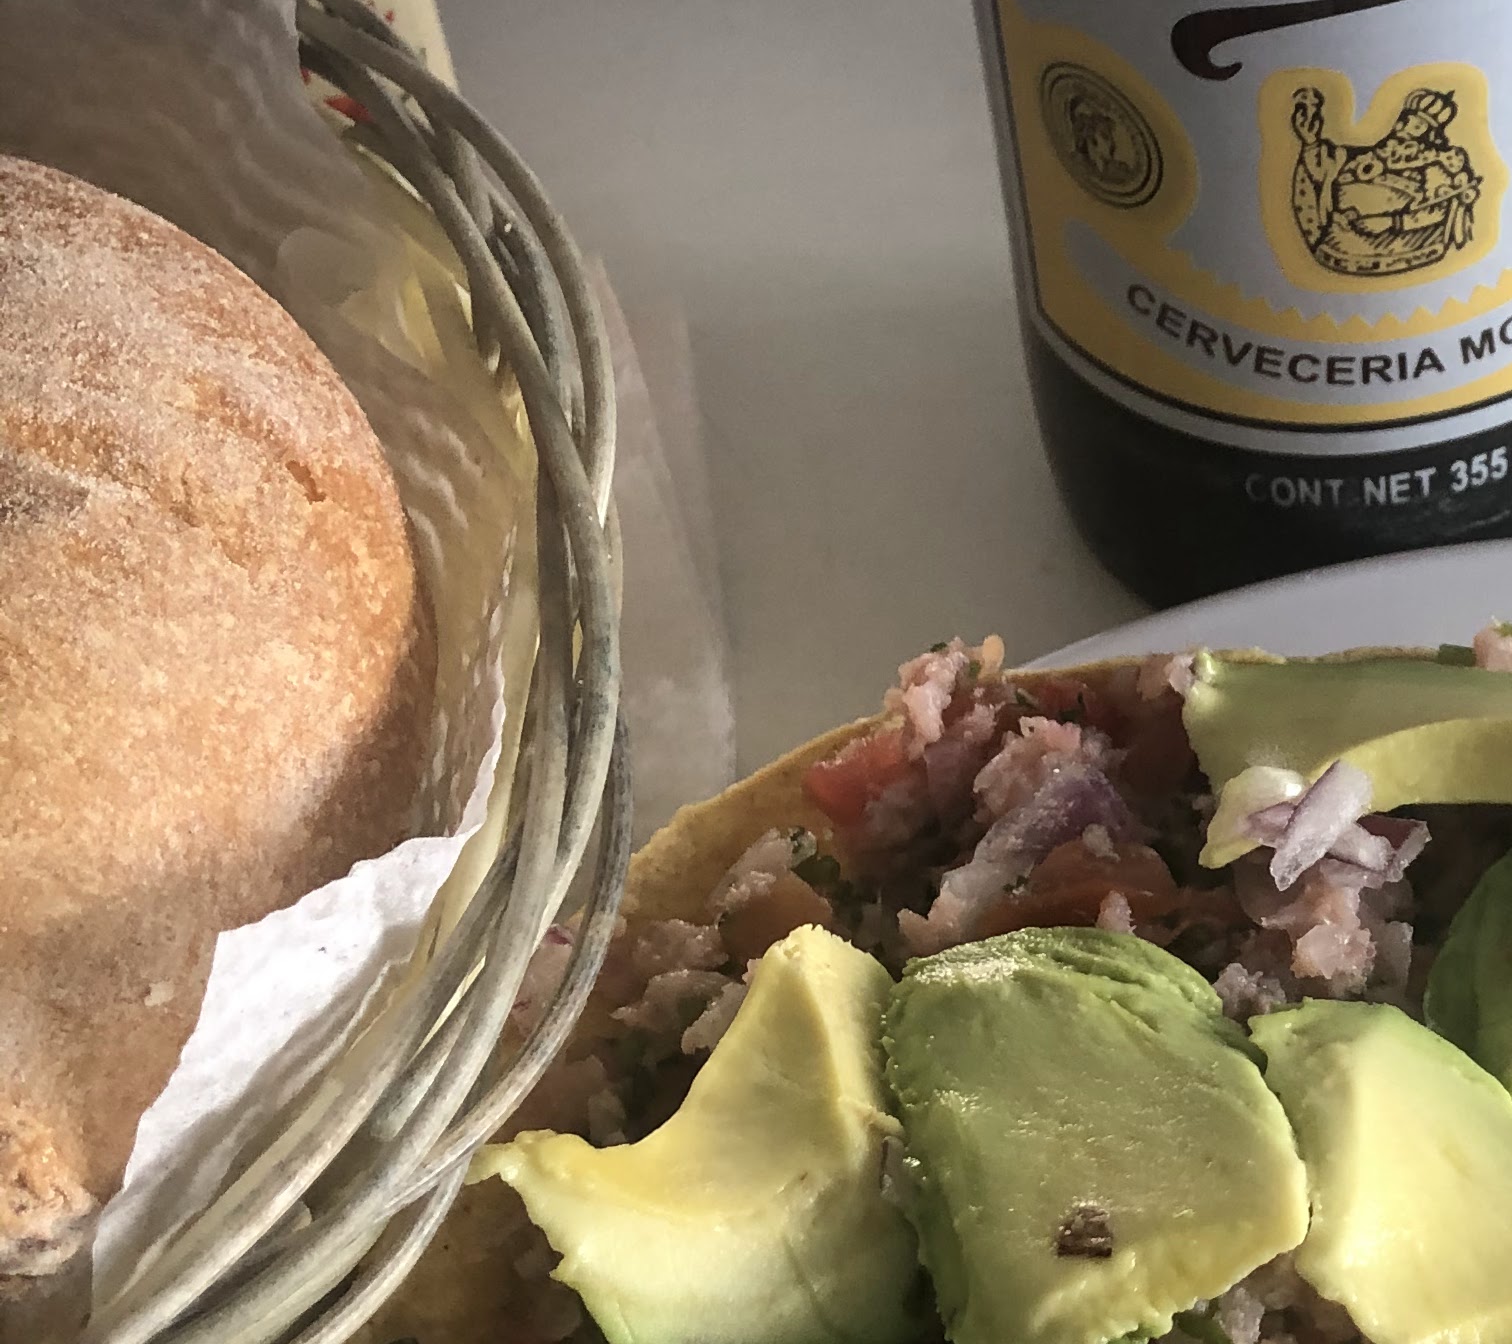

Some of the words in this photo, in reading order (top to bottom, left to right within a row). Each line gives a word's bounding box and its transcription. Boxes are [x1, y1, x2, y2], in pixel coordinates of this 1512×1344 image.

[1126, 282, 1447, 386] CERVECERIA
[1244, 472, 1344, 508] CONT
[1364, 466, 1438, 506] NET
[1450, 446, 1508, 494] 355
